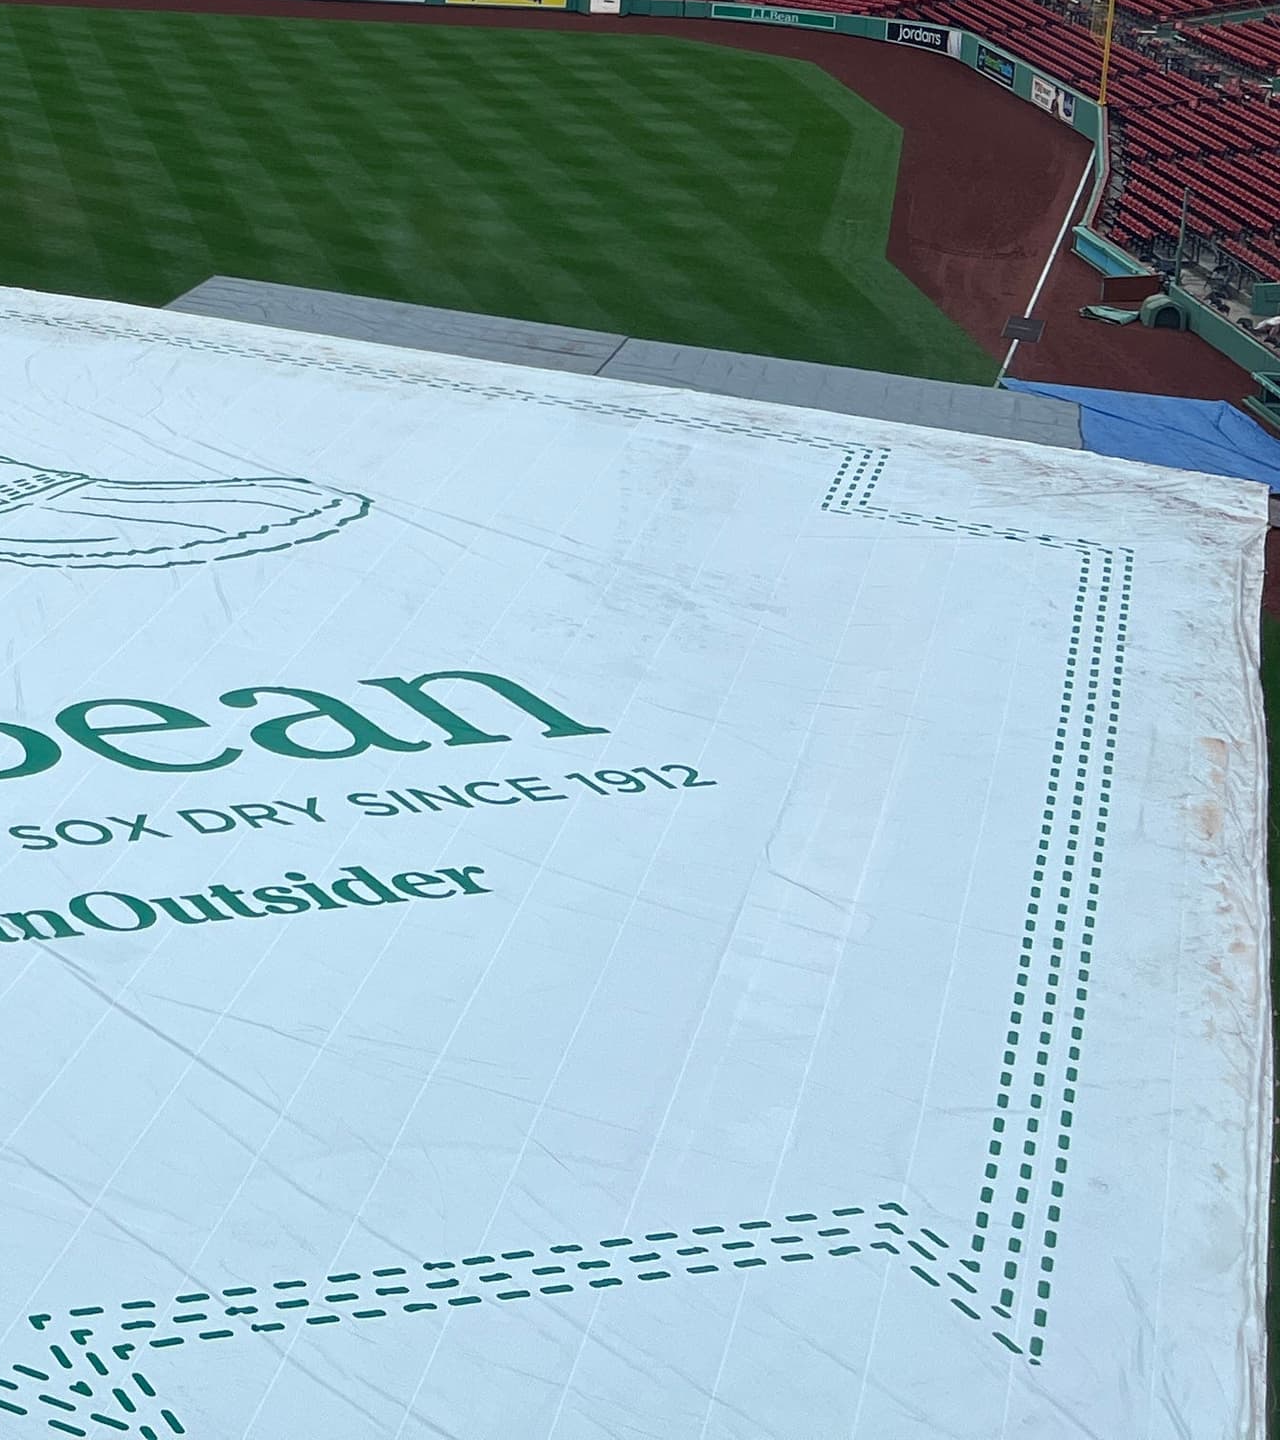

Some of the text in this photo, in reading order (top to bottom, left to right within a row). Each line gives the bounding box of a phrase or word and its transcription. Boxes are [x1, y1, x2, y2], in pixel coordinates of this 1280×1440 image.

[8, 812, 173, 851] SOX
[177, 796, 327, 835] DRY
[347, 776, 569, 817] SINCE
[565, 763, 717, 796] 1912
